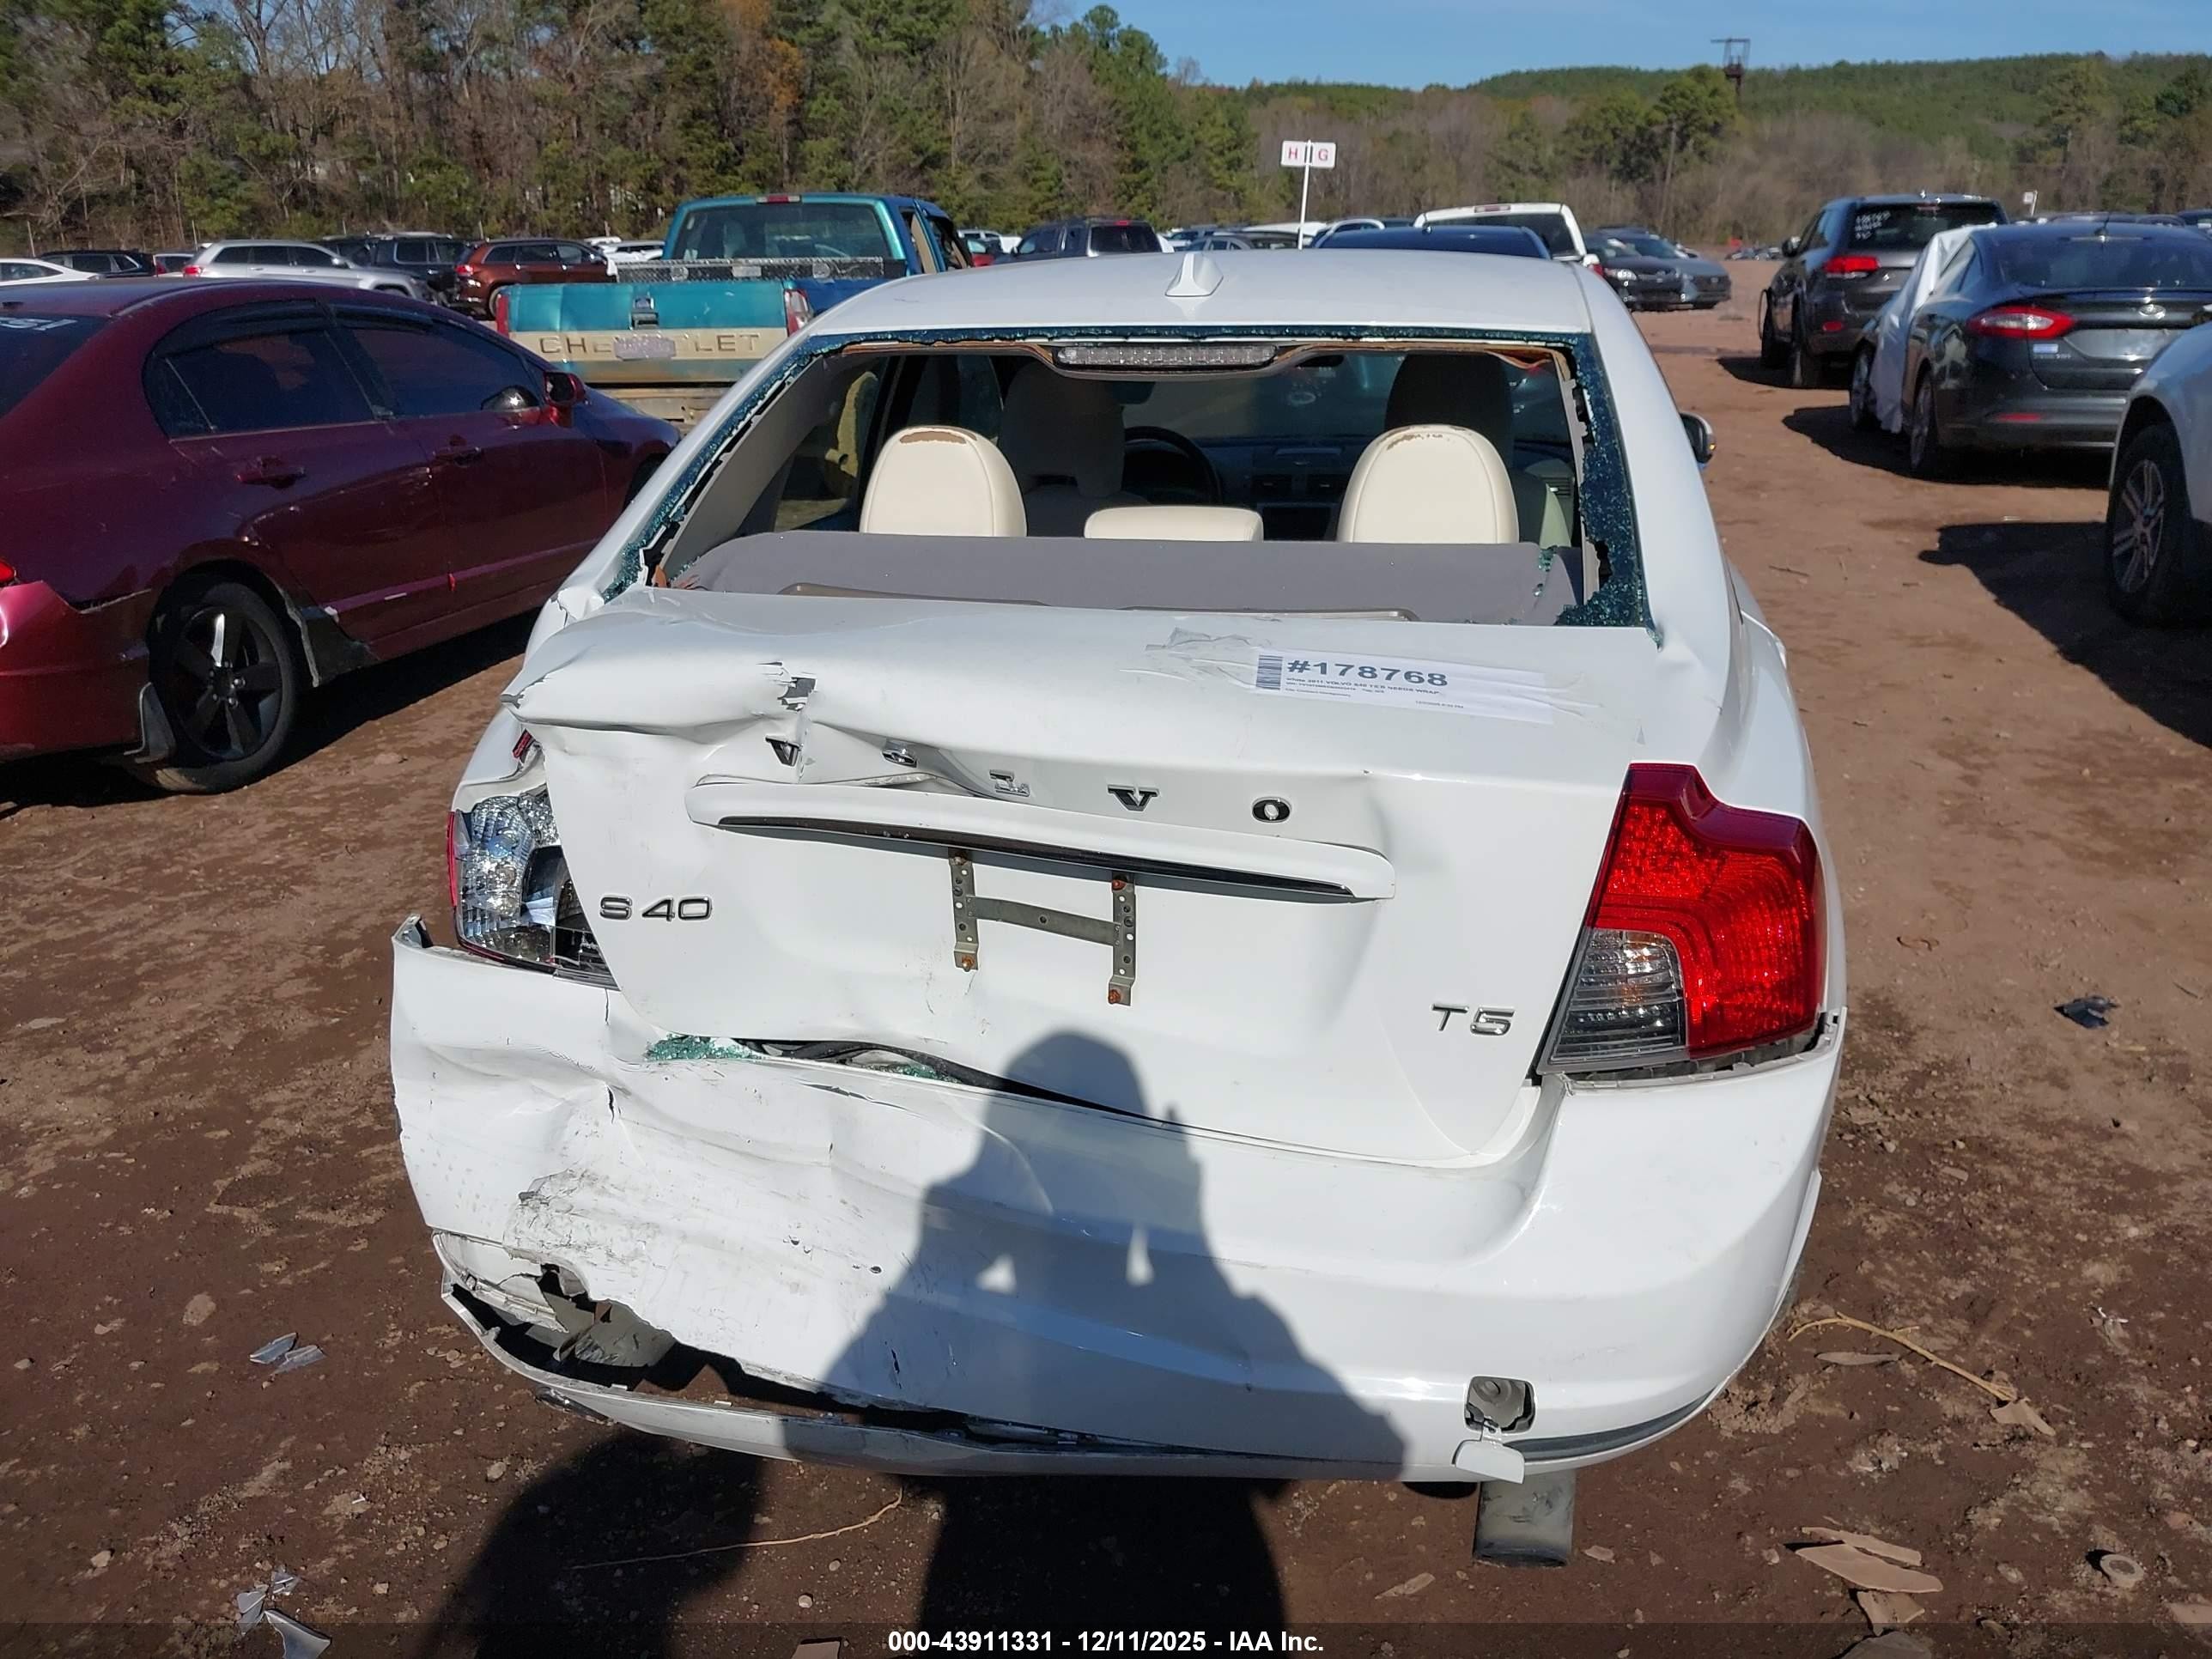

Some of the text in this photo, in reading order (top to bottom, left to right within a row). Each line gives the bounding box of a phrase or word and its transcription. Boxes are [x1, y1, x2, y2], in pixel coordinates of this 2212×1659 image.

[1288, 147, 1298, 159] H
[1318, 149, 1328, 161] G
[1287, 659, 1448, 686] #178768
[599, 896, 714, 921] S40
[1431, 1003, 1516, 1036] T5
